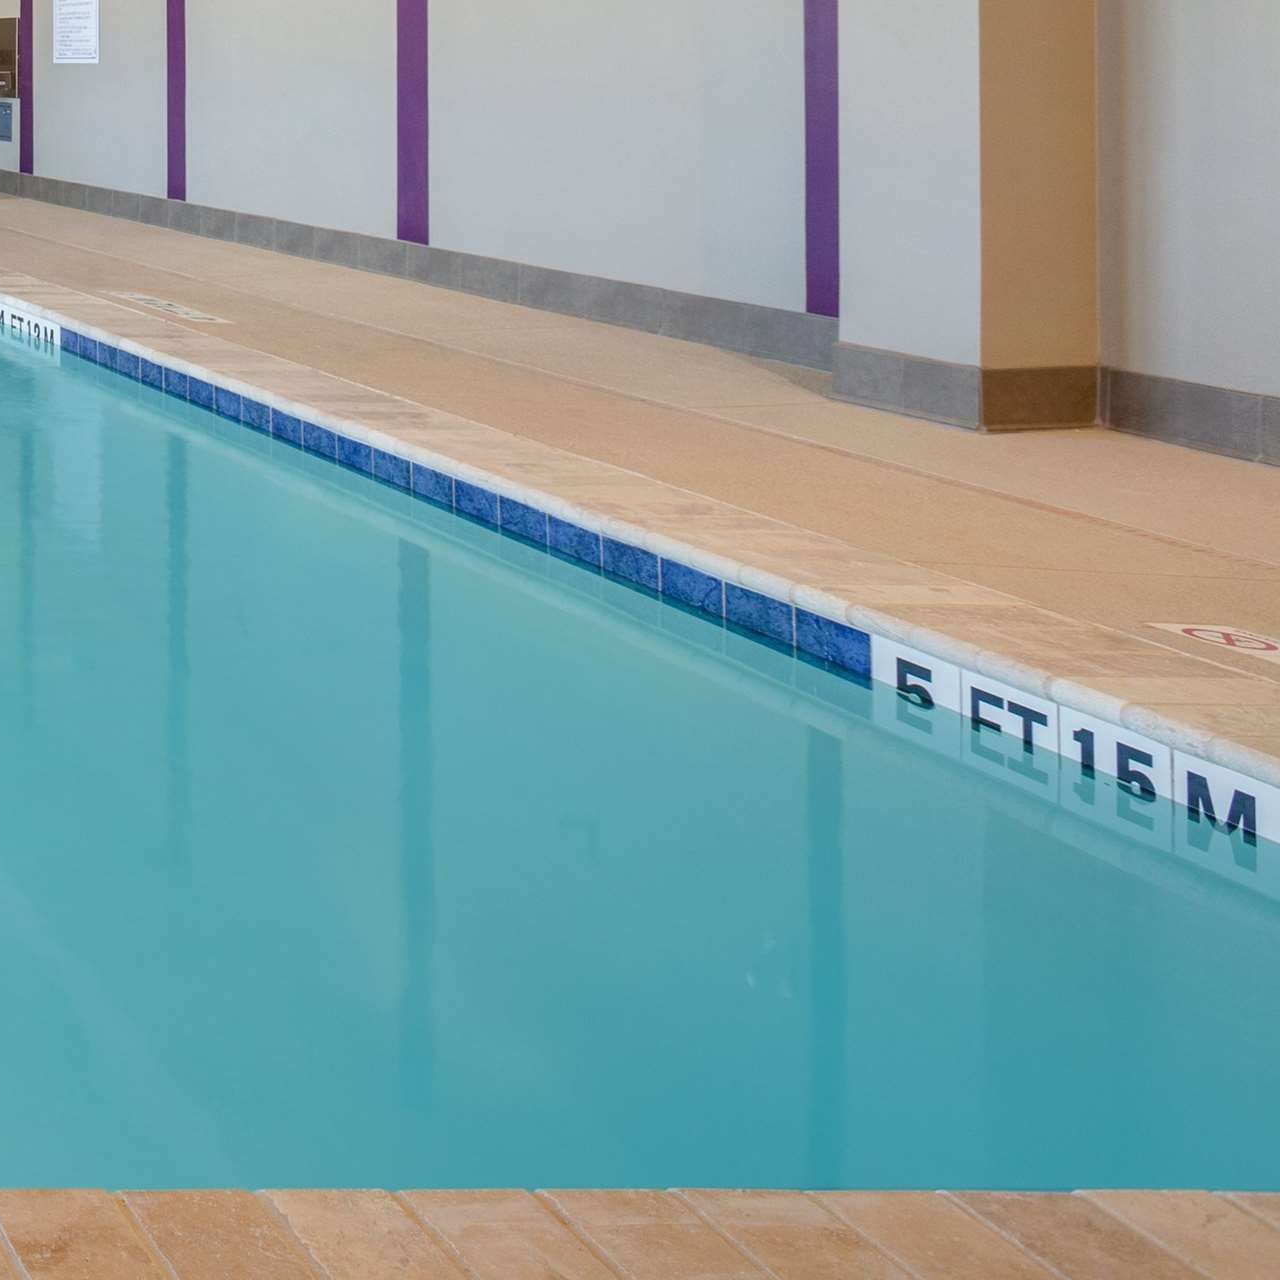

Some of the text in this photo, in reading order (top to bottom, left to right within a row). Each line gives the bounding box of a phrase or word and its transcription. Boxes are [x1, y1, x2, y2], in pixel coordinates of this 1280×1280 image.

[10, 314, 24, 333] FT
[44, 326, 54, 345] M
[896, 657, 934, 710] 5
[970, 686, 1048, 755] FT
[1187, 770, 1258, 848] M
